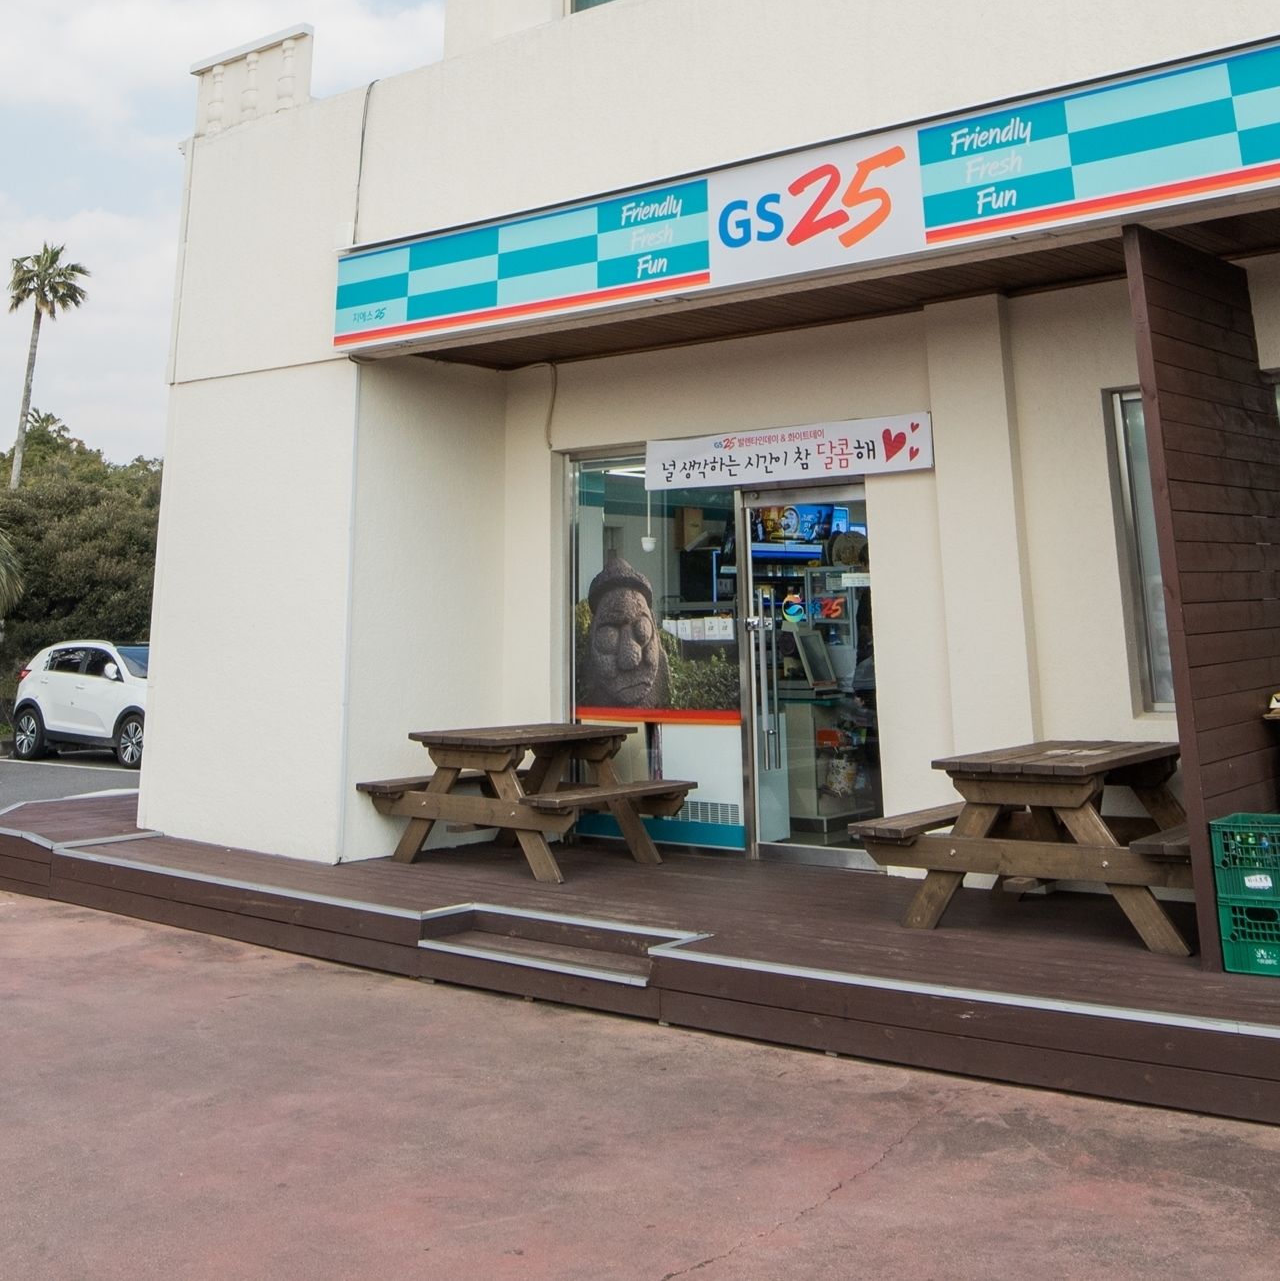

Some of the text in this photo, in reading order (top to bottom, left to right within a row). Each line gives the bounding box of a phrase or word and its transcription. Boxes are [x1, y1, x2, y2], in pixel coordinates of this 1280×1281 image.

[950, 117, 1032, 156] Friendly
[966, 149, 1023, 184] Fresh
[621, 194, 683, 226] Friendly
[718, 145, 906, 249] GS25
[977, 186, 1017, 215] Fun
[631, 223, 674, 251] Fresh
[637, 254, 668, 279] Fun
[713, 436, 737, 450] GS25
[788, 429, 825, 442] 화이트데이
[662, 438, 877, 482] 널 생각하는 시간이 참 달콤해
